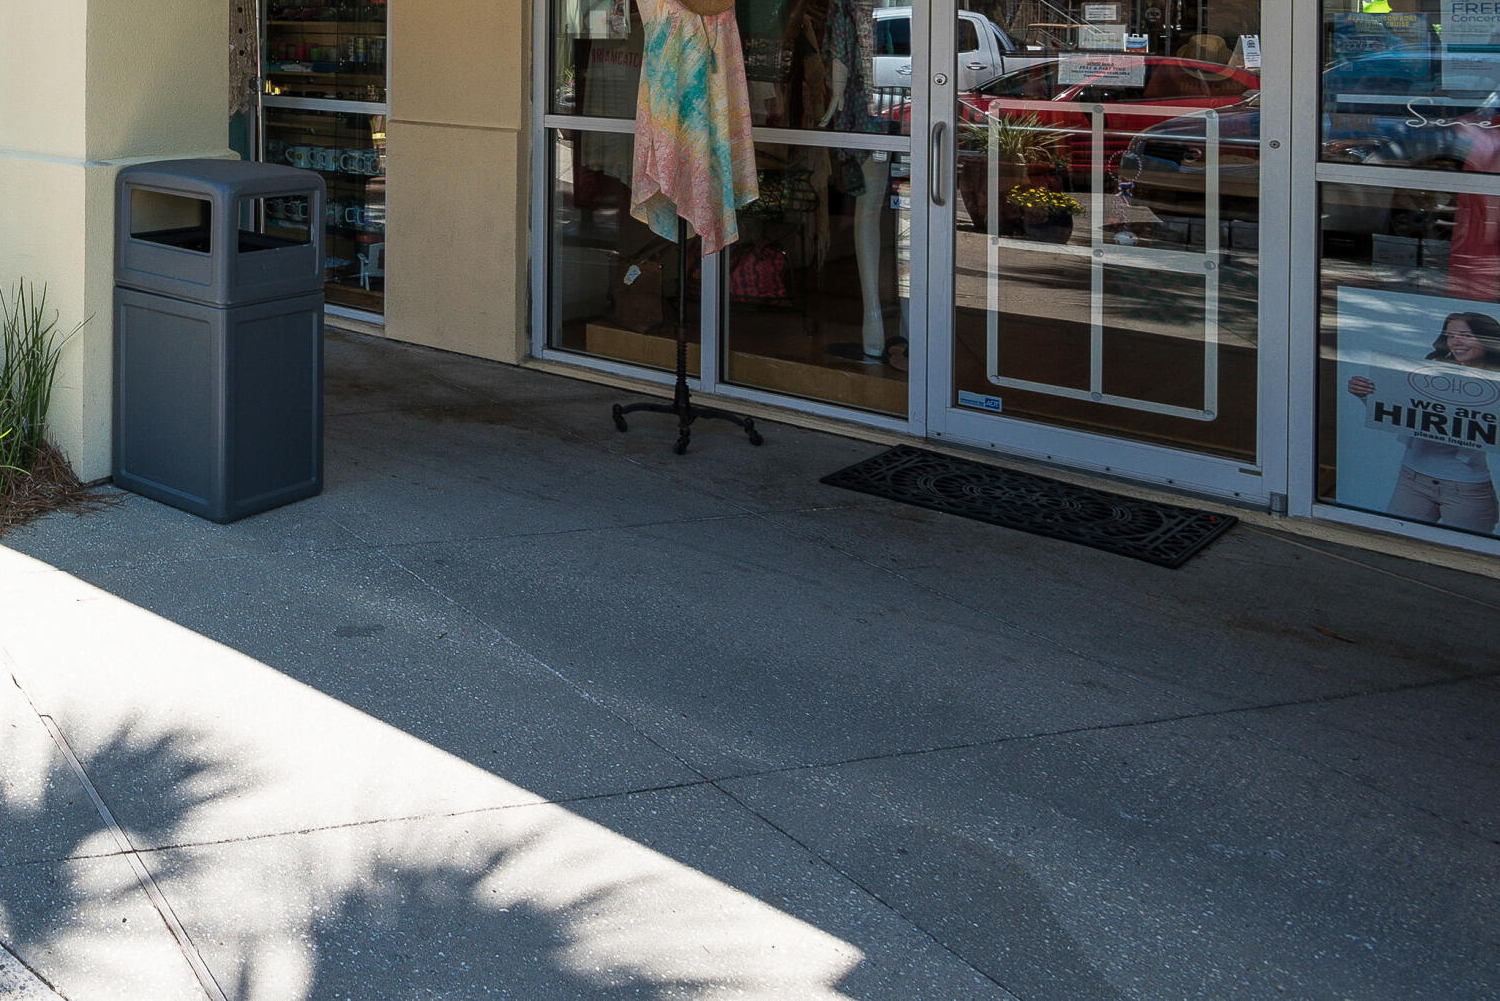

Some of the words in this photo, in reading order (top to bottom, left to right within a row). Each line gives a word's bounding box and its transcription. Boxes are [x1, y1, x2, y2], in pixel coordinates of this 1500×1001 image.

[1419, 374, 1484, 398] SOHO
[1374, 401, 1498, 446] HIRIN
[1410, 398, 1446, 414] we
[1455, 407, 1497, 424] are
[1413, 430, 1446, 442] please
[1448, 437, 1483, 449] inquire
